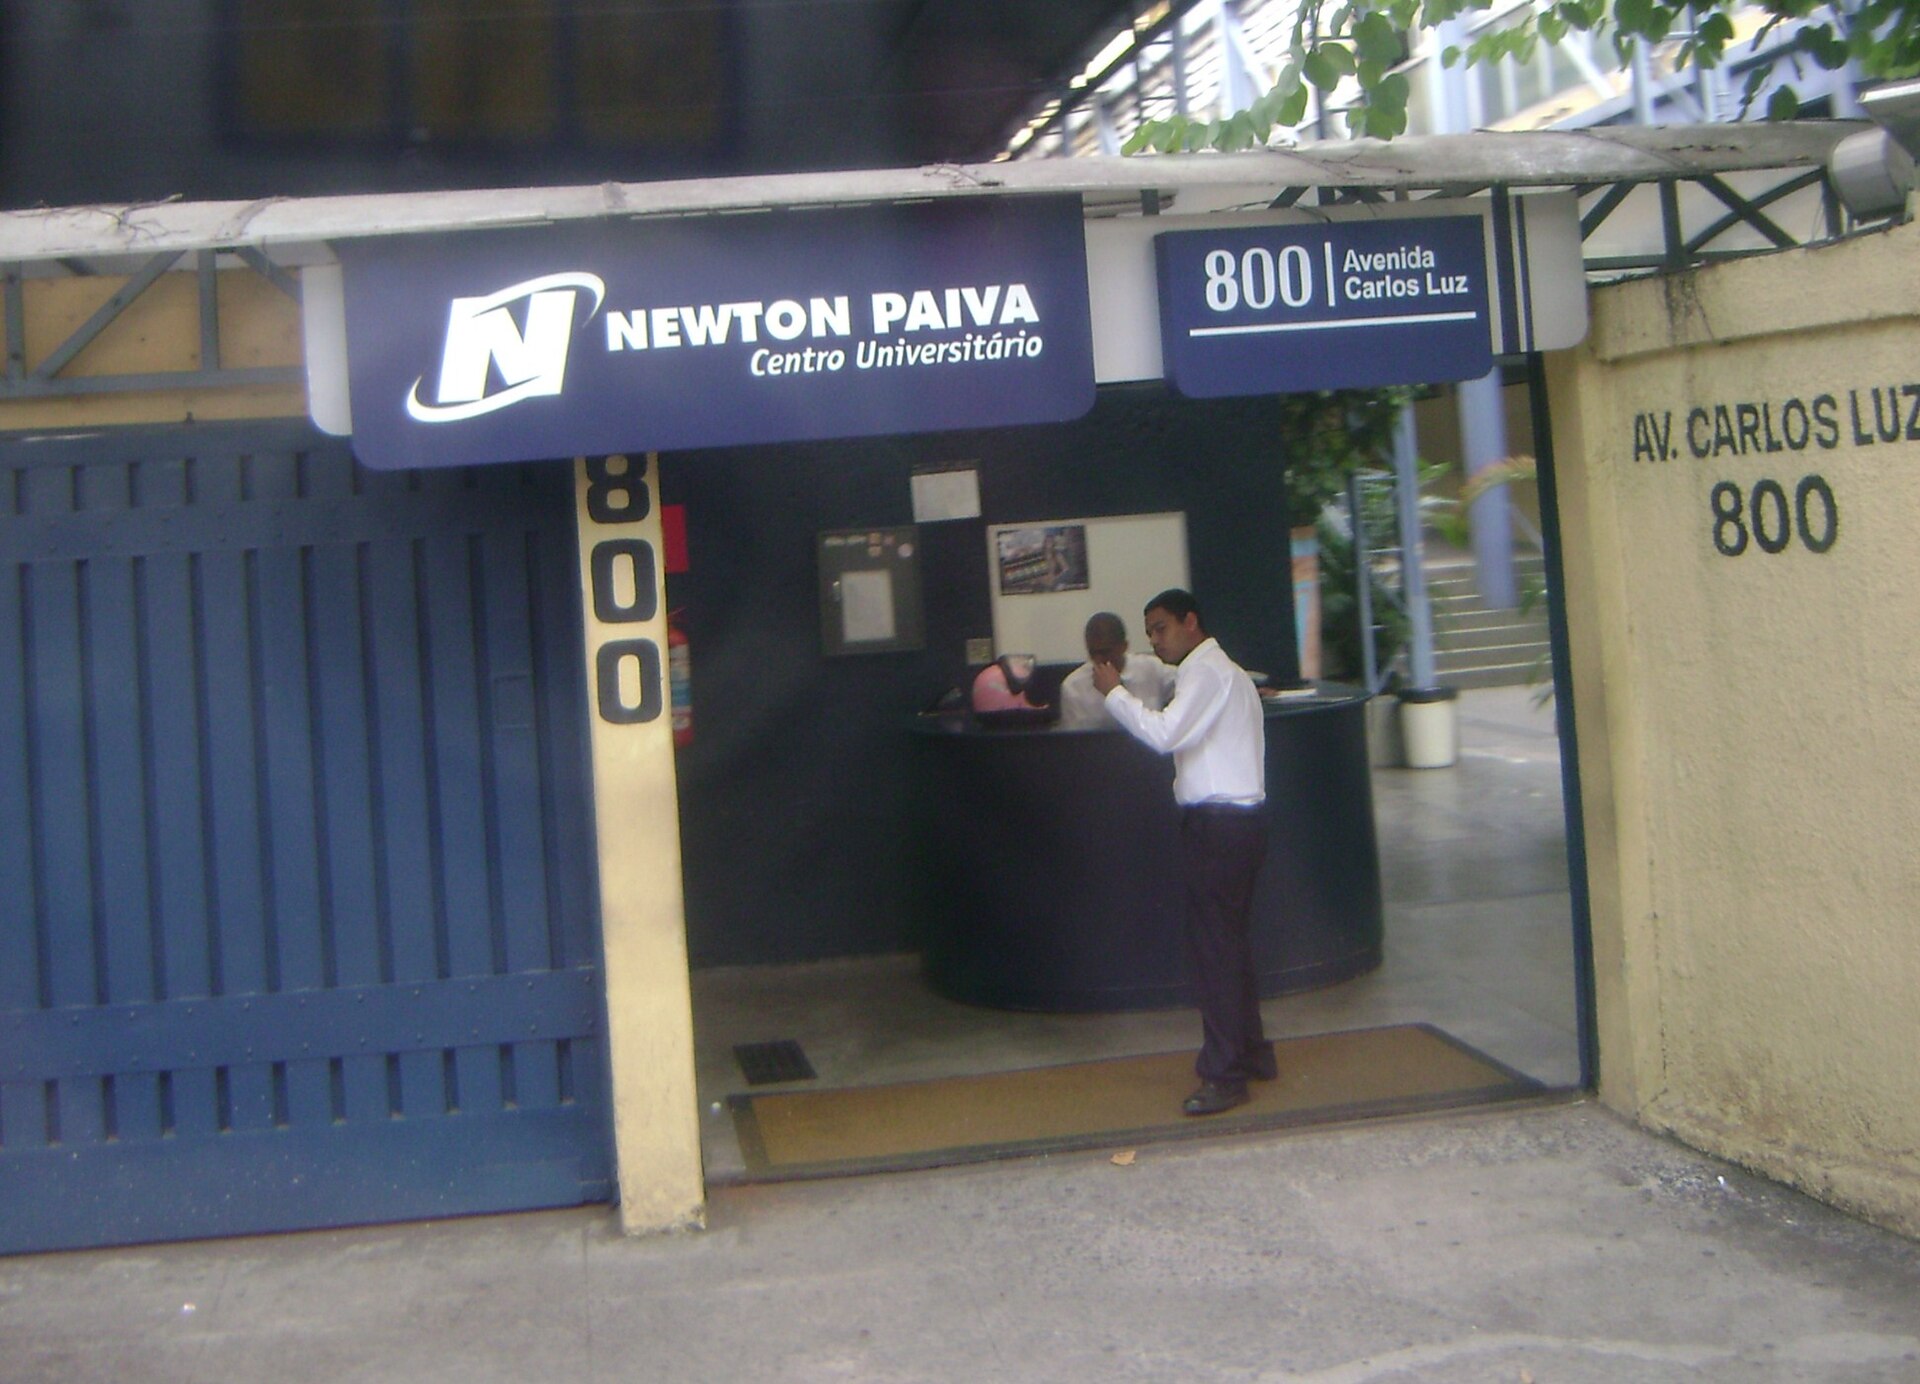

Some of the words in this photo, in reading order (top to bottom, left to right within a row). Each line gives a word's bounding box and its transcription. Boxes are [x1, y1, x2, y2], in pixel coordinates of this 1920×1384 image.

[1204, 245, 1313, 312] 800
[1342, 246, 1435, 273] Avenida
[1344, 276, 1420, 301] Carlos
[1426, 272, 1469, 296] Luz
[606, 295, 852, 352] NEWTON
[872, 284, 1041, 334] PAIVA
[750, 345, 846, 378] Centro
[856, 332, 1044, 369] Universitário
[1633, 411, 1678, 462] AV.
[1686, 393, 1840, 459] CARLOS
[1849, 383, 1920, 447] LUZ
[1710, 474, 1838, 557] 800
[585, 454, 662, 725] 800
